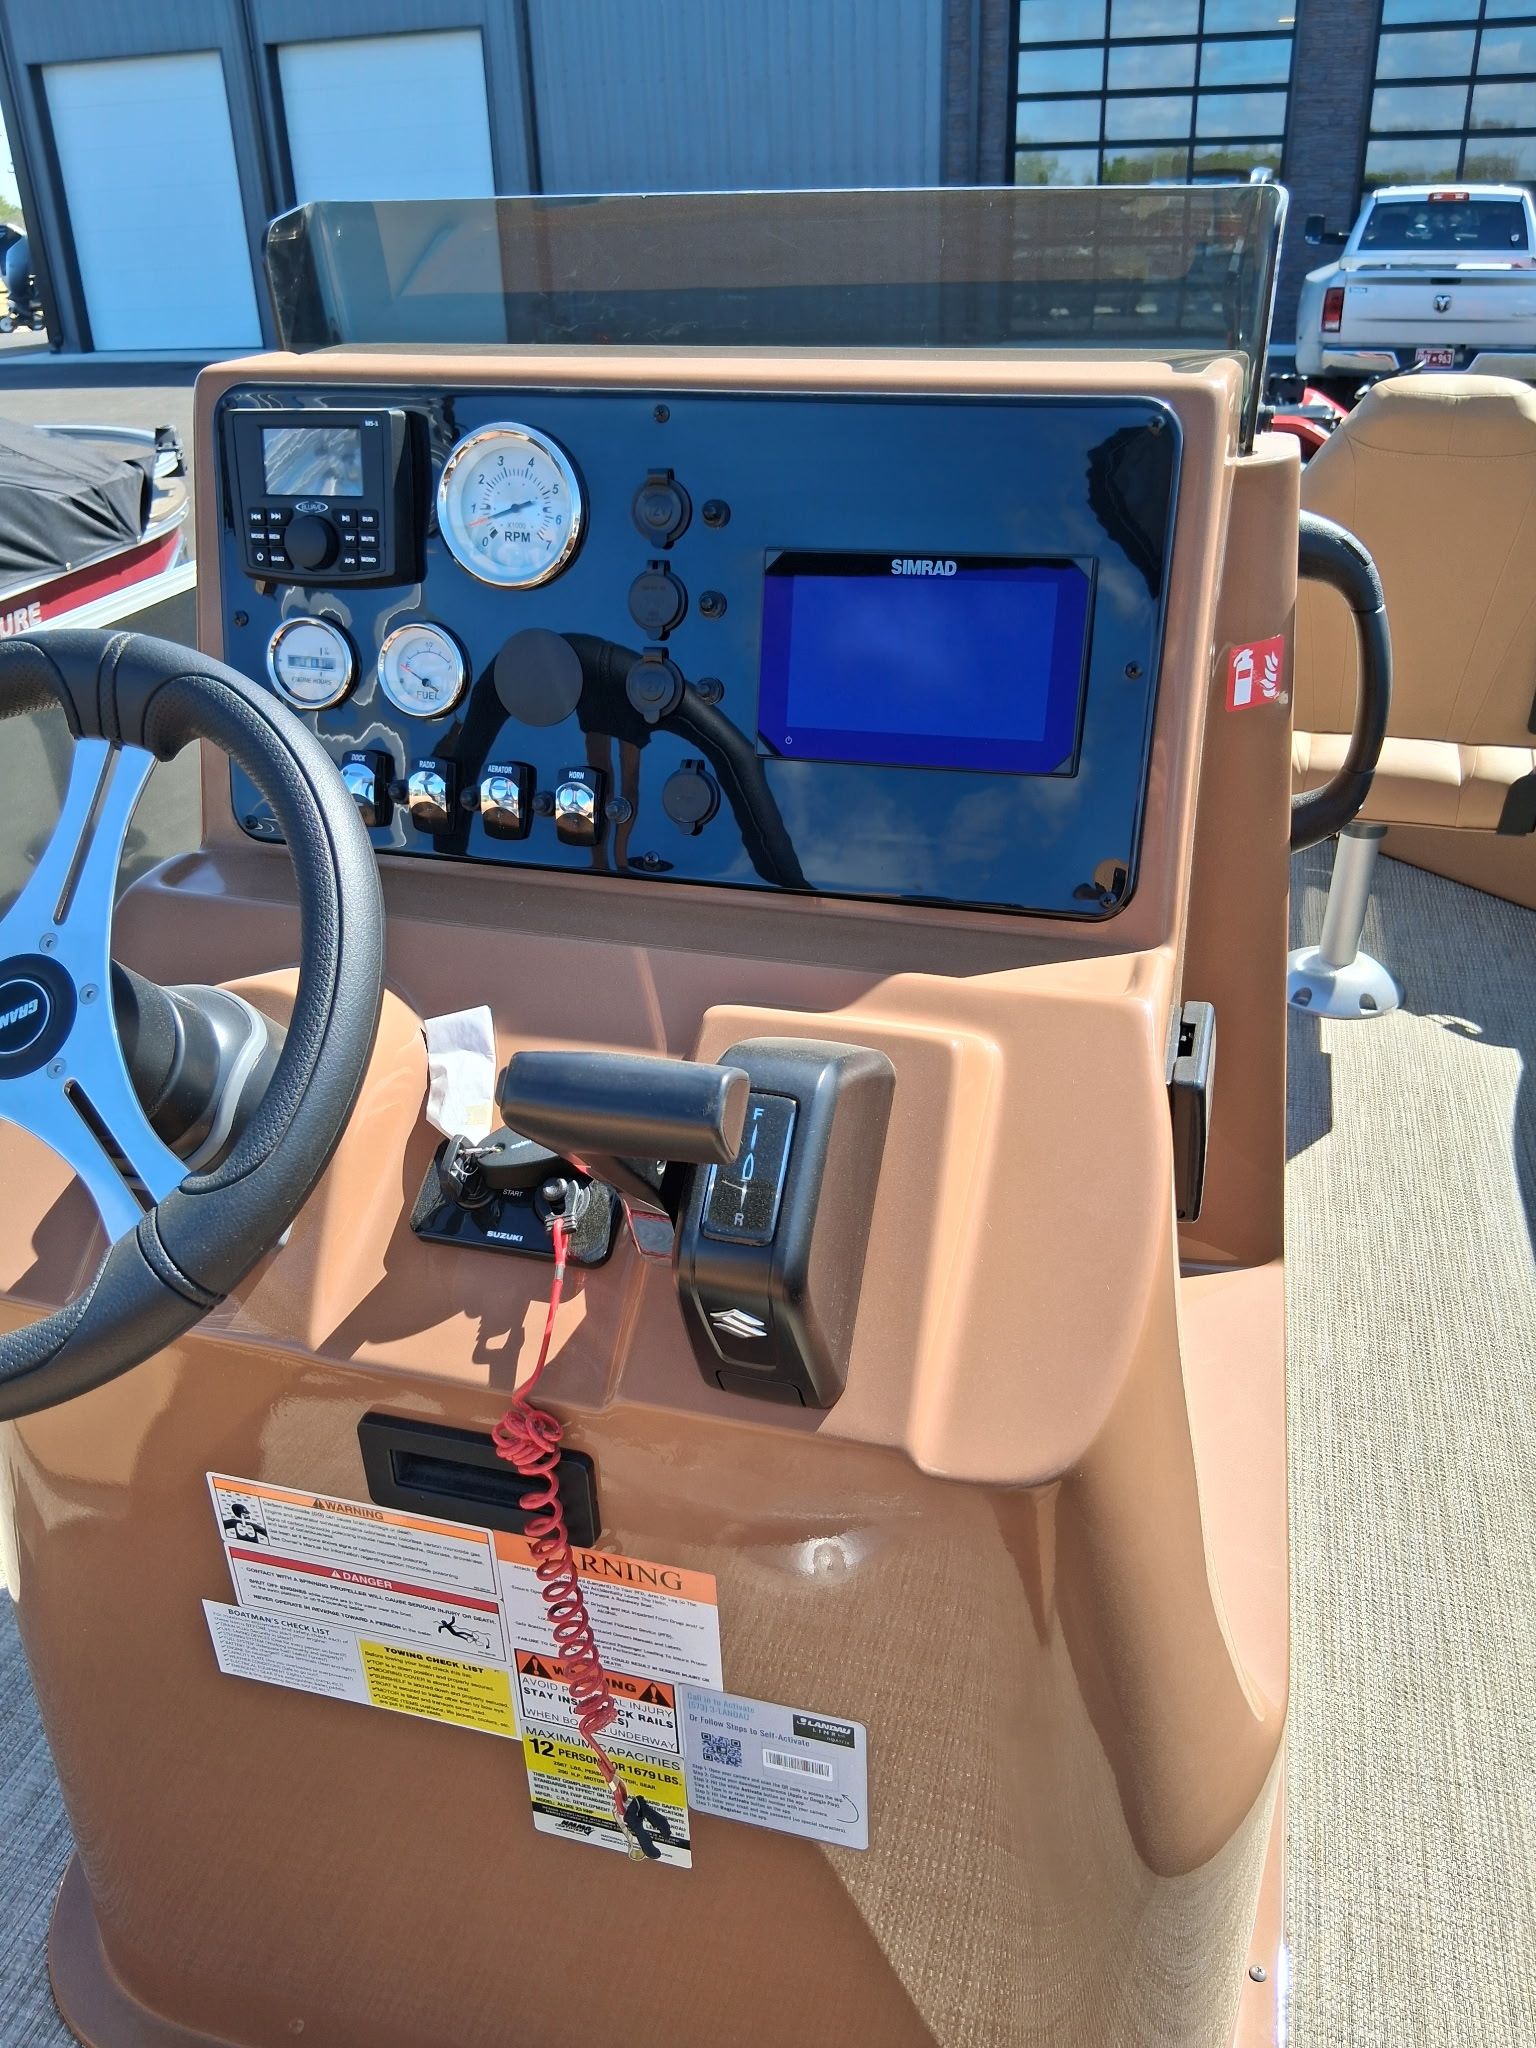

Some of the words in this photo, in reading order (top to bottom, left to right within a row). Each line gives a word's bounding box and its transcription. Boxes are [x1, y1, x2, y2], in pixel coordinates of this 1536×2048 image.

[497, 455, 504, 467] 3
[528, 457, 535, 467] 4
[478, 474, 485, 485] 2
[552, 484, 559, 494] 5
[471, 503, 476, 513] 1
[555, 514, 562, 525] 6
[360, 535, 376, 543] MUTE
[482, 536, 489, 547] 0
[504, 531, 531, 542] RPM
[546, 540, 552, 551] 7
[890, 558, 958, 577] SIMRAD
[0, 601, 42, 637] URE
[416, 690, 440, 701] FUEL
[350, 753, 366, 762] DOCK
[418, 760, 436, 769] RADIO
[487, 765, 513, 774] AERATOR
[568, 770, 585, 780] HORN
[752, 1107, 765, 1120] F
[502, 1188, 524, 1197] START
[733, 1212, 745, 1226] R
[486, 1230, 524, 1242] SUZUKI
[324, 1500, 384, 1521] WARNING
[525, 1540, 683, 1592] RNING
[341, 1571, 393, 1589] DANGER
[227, 1607, 279, 1625] BOATMAN'S
[280, 1619, 310, 1631] CHECK
[311, 1626, 330, 1636] LIST
[383, 1645, 423, 1660] TOWING
[425, 1655, 459, 1668] CHECK
[462, 1663, 484, 1674] LIST
[552, 1664, 636, 1693] WING
[521, 1675, 558, 1691] AVOID
[629, 1701, 672, 1719] INJURY
[523, 1686, 553, 1700] STAY
[637, 1713, 673, 1729] RAILS
[526, 1707, 559, 1721] WHEN
[609, 1727, 675, 1750] UNDERWAY
[700, 1715, 723, 1728] Follow
[725, 1721, 747, 1734] Steps
[749, 1727, 757, 1735] to
[759, 1728, 810, 1748] Self-Activate
[807, 1719, 851, 1735] LANDAU
[525, 1724, 593, 1750] MAXIMUM
[598, 1742, 680, 1771] CAPACITIES
[528, 1736, 555, 1758] 12
[558, 1747, 601, 1766] PERSON
[627, 1764, 656, 1780] 1679
[657, 1772, 682, 1786] LBS.
[546, 1774, 560, 1782] BOAT
